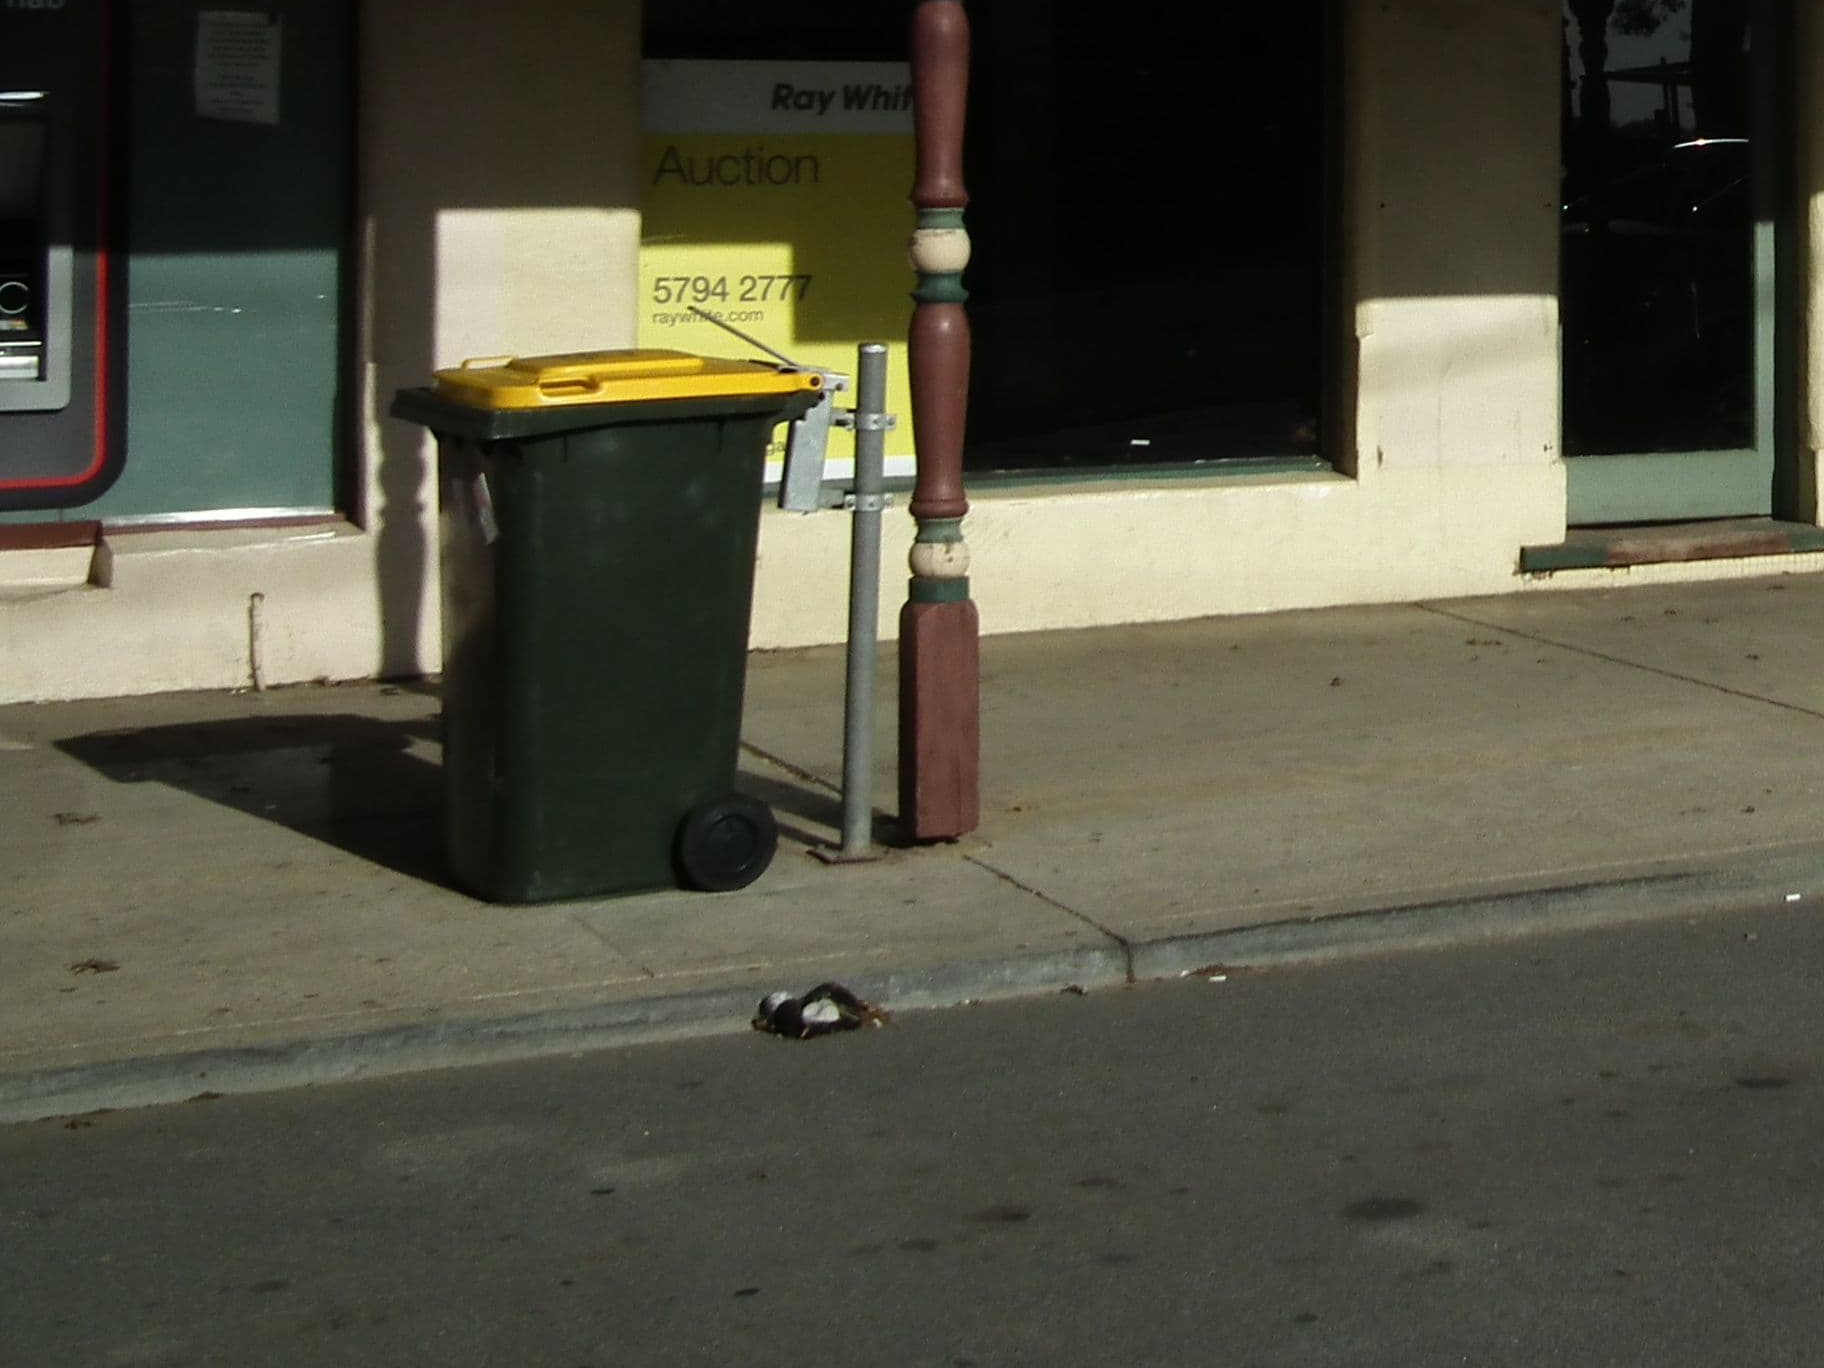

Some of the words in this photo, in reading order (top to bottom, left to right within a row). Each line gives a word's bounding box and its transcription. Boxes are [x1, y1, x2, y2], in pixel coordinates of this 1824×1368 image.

[771, 82, 836, 116] Ray
[843, 84, 914, 111] Whit
[652, 144, 820, 186] Auction
[653, 275, 730, 304] 5794
[739, 274, 813, 302] 2777
